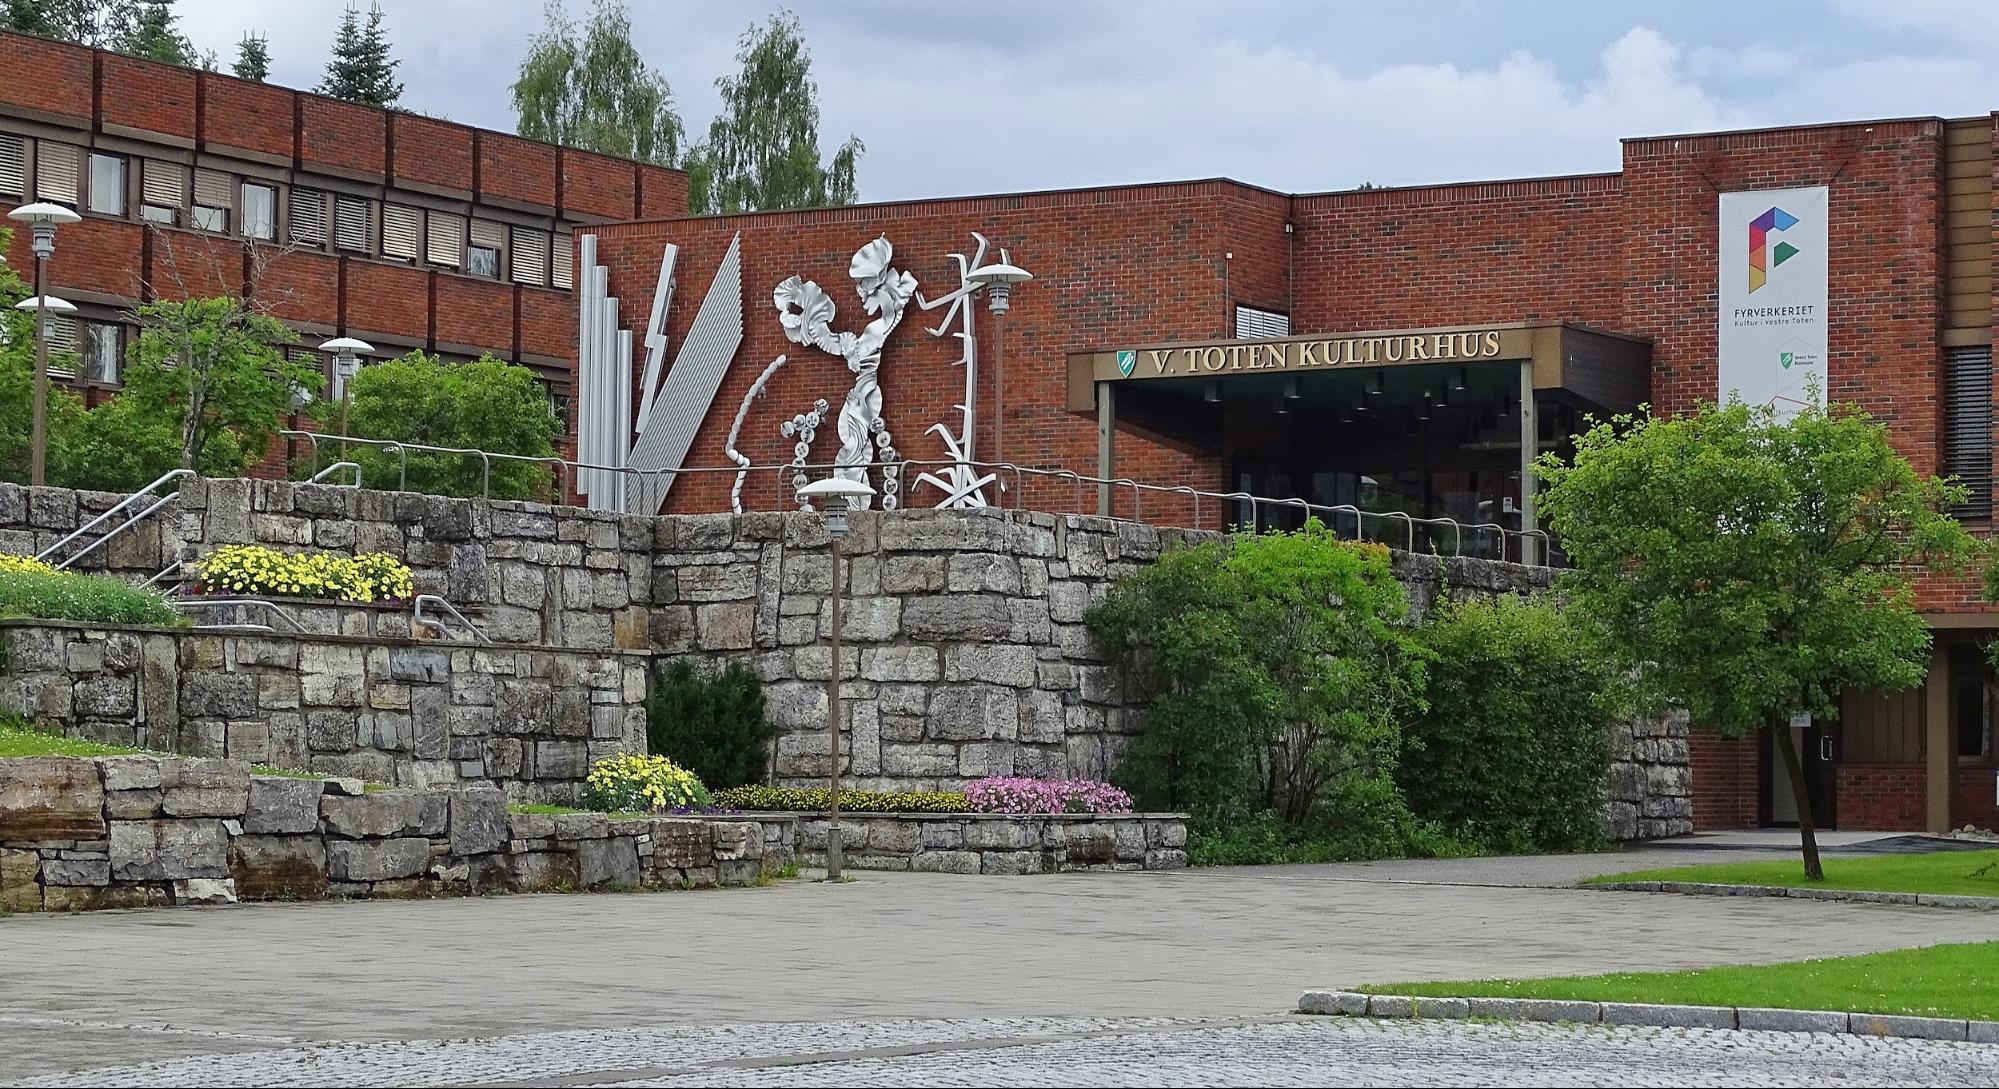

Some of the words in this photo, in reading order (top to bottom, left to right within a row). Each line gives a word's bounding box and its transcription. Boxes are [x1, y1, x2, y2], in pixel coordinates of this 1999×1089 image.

[1734, 305, 1815, 318] FYRVERKERIET
[1734, 319, 1758, 327] Kultur
[1792, 317, 1815, 325] Toten
[1150, 349, 1176, 374] V.
[1183, 343, 1290, 372] TOTEN
[1296, 331, 1500, 366] KULTURHUS
